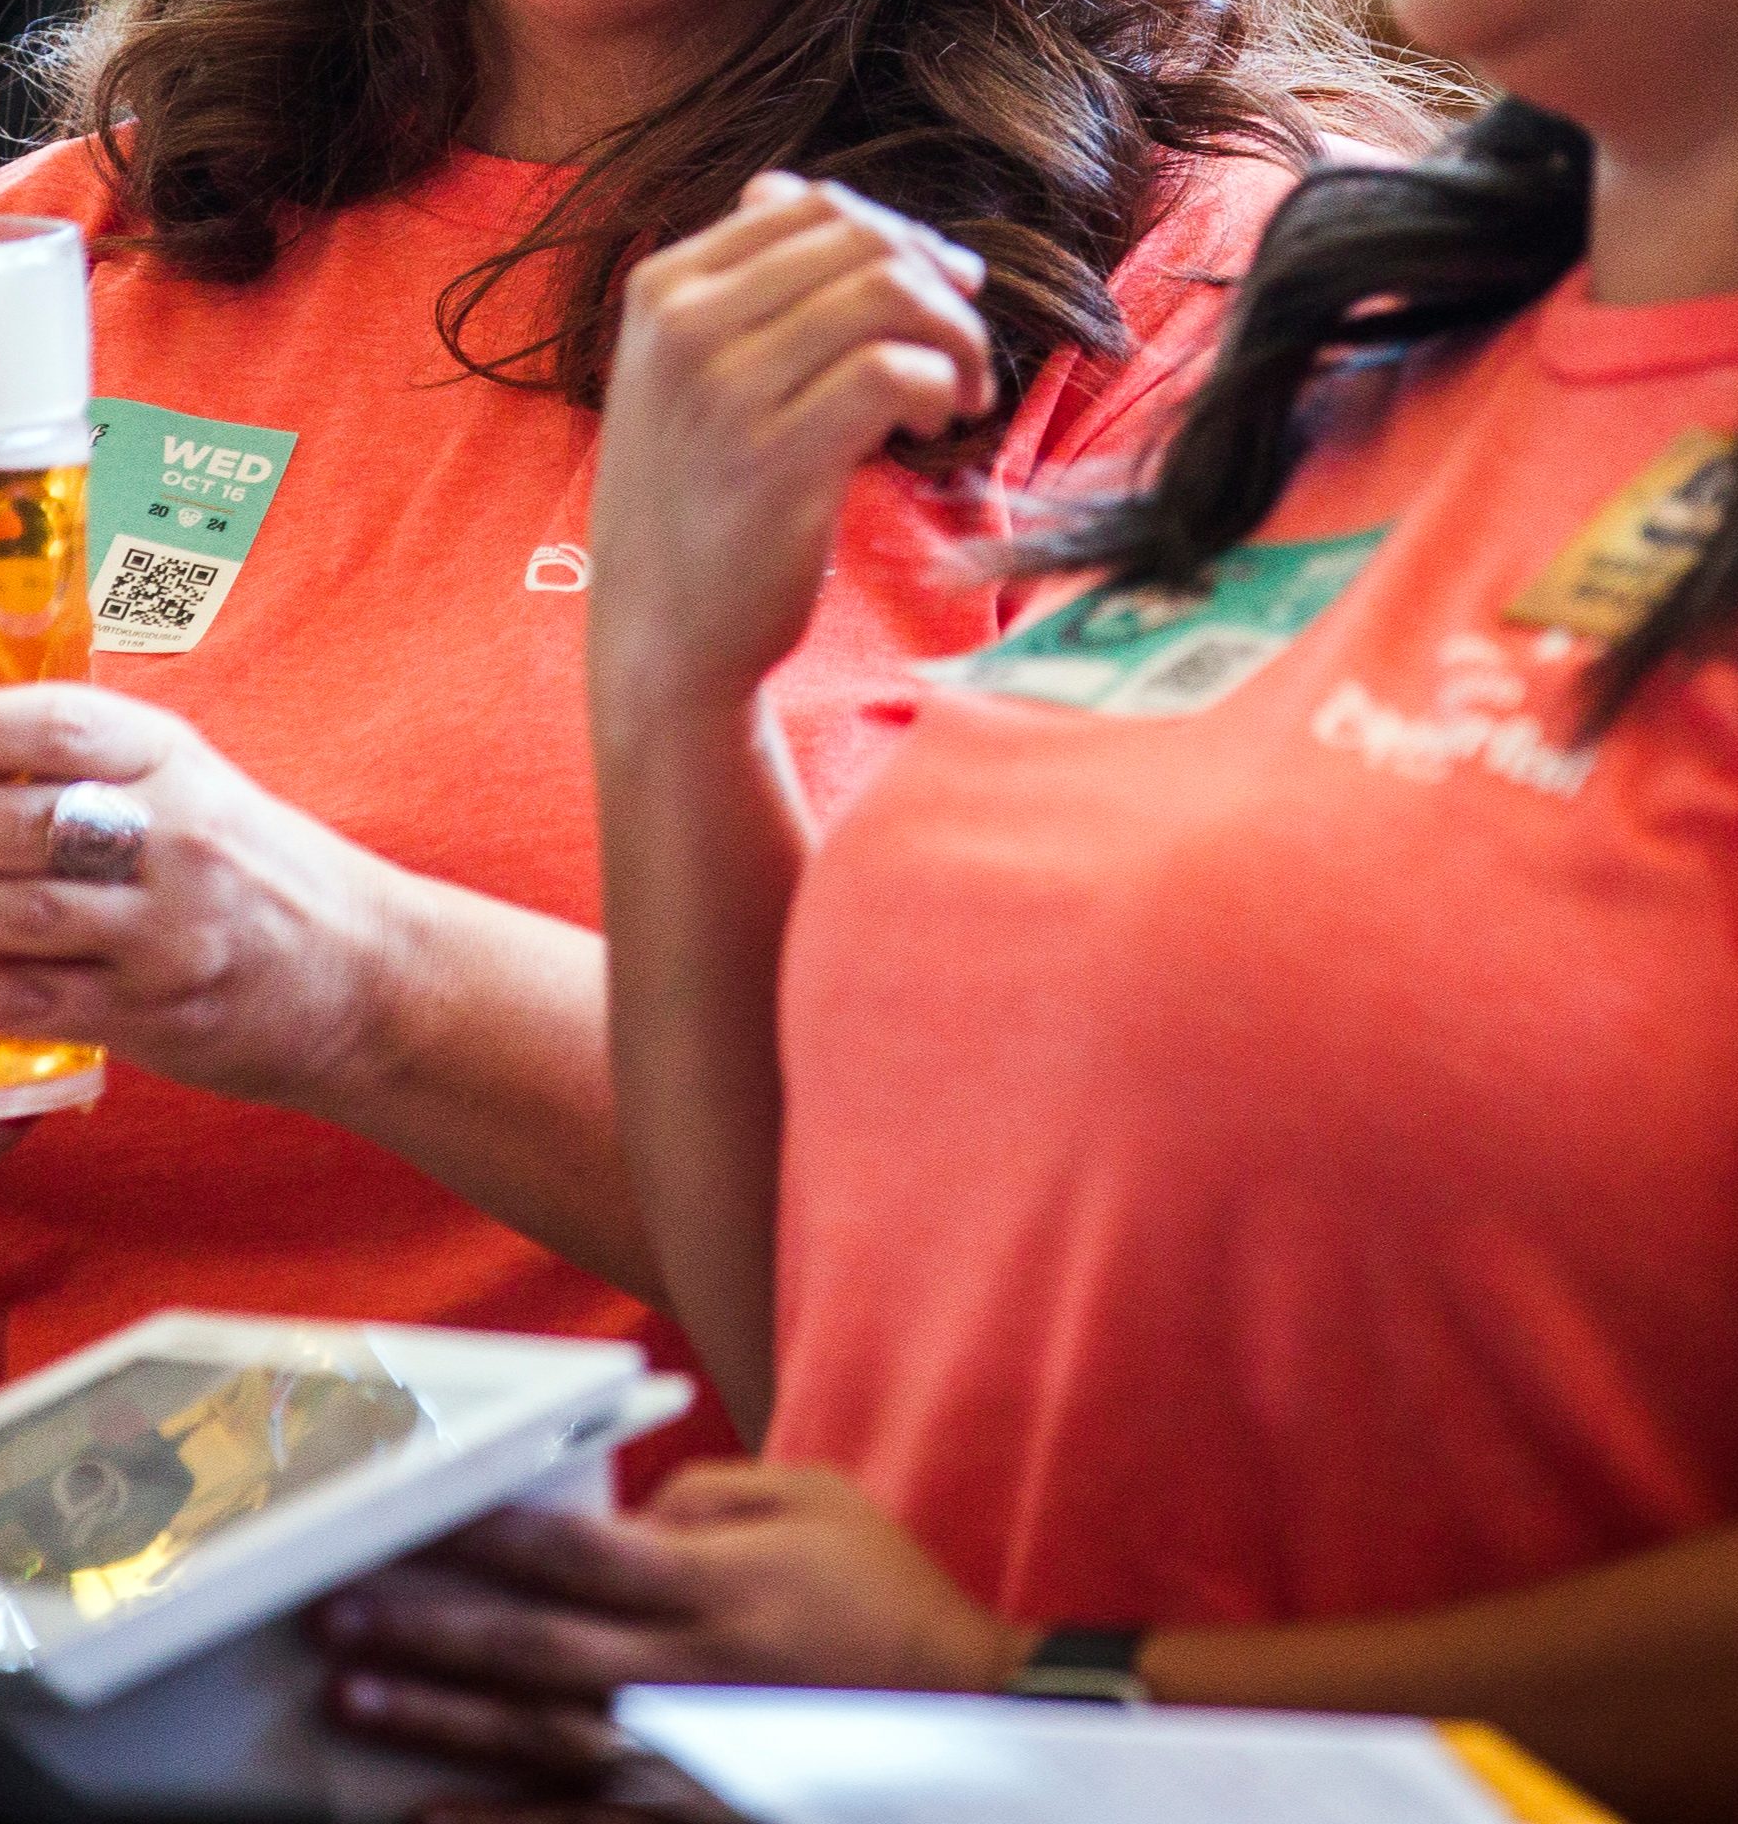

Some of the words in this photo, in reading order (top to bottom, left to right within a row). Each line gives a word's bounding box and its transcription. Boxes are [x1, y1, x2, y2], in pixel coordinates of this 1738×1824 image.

[163, 434, 273, 484] WED
[161, 470, 216, 495] OCT
[221, 484, 246, 503] 16
[147, 502, 170, 519] 20
[205, 516, 228, 533] 24
